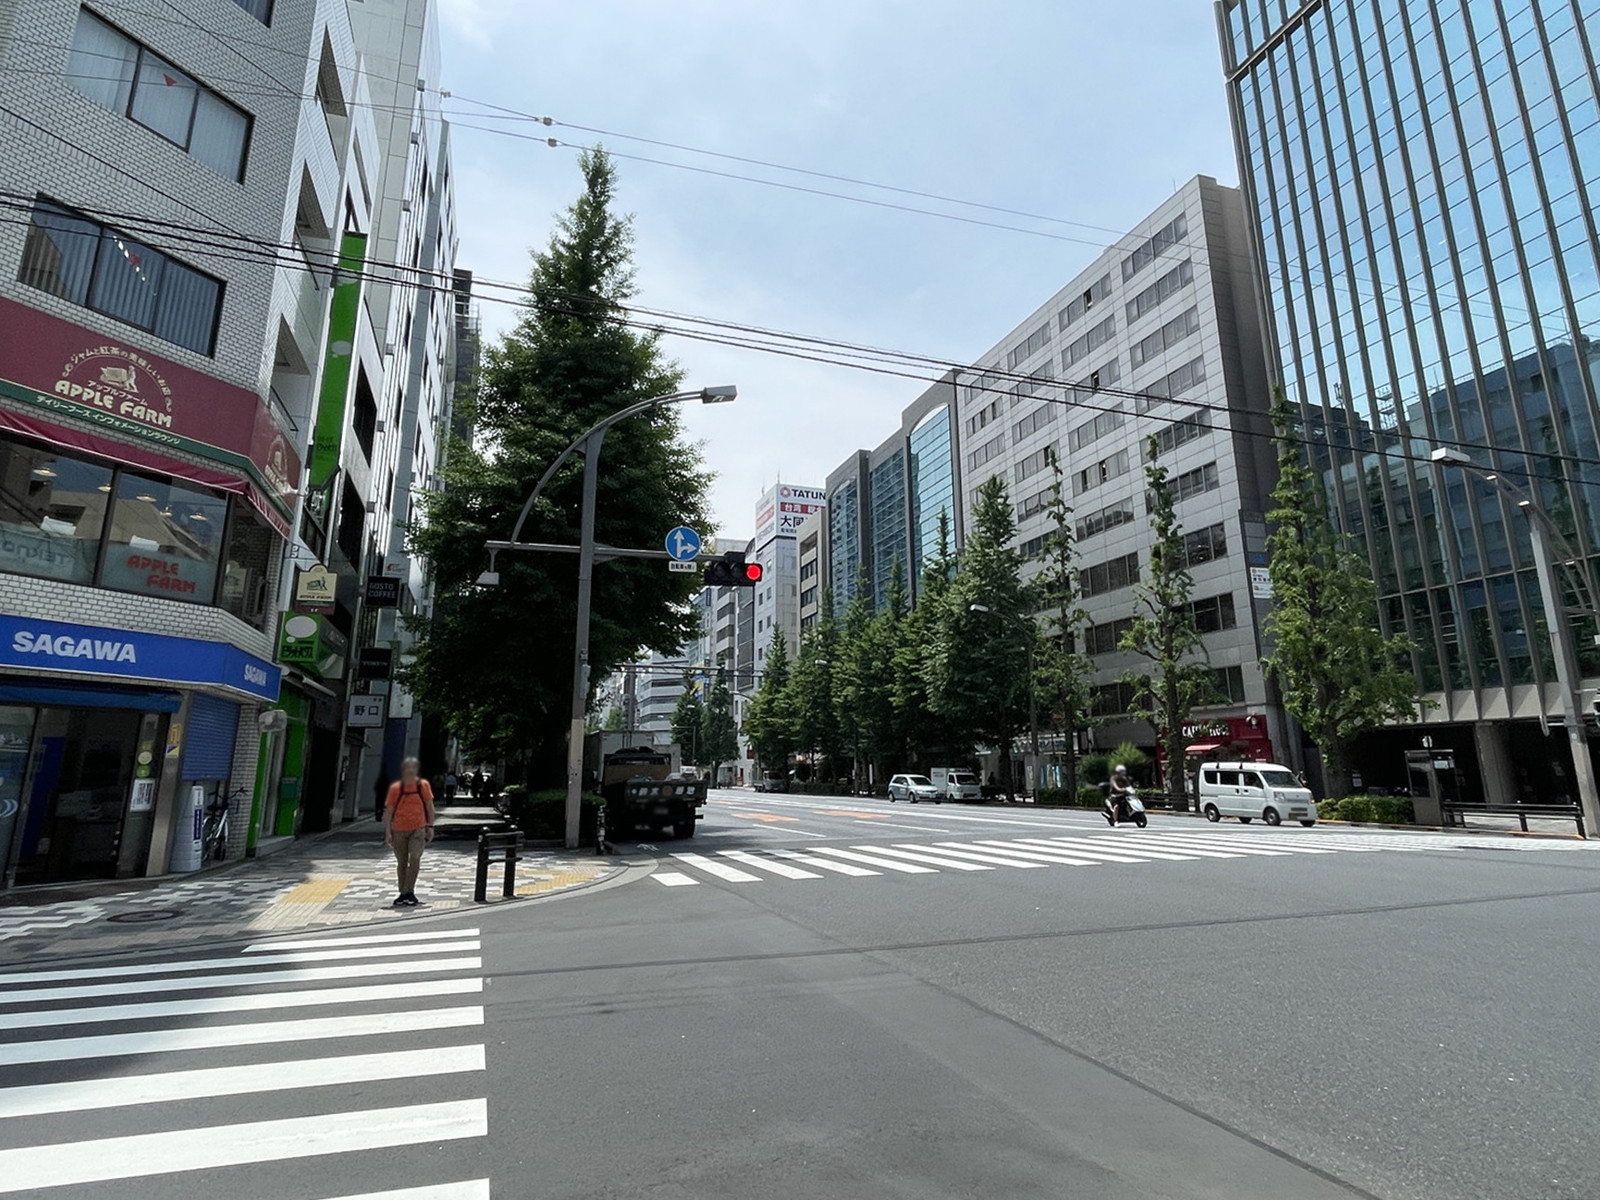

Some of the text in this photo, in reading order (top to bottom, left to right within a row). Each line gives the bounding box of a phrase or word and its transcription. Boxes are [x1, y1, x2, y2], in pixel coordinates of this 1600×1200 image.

[54, 380, 172, 428] APPLE FARM
[127, 555, 179, 576] APPLE
[146, 576, 196, 594] FARM
[12, 631, 136, 663] SAGAWA
[244, 663, 267, 687] SAGAWA
